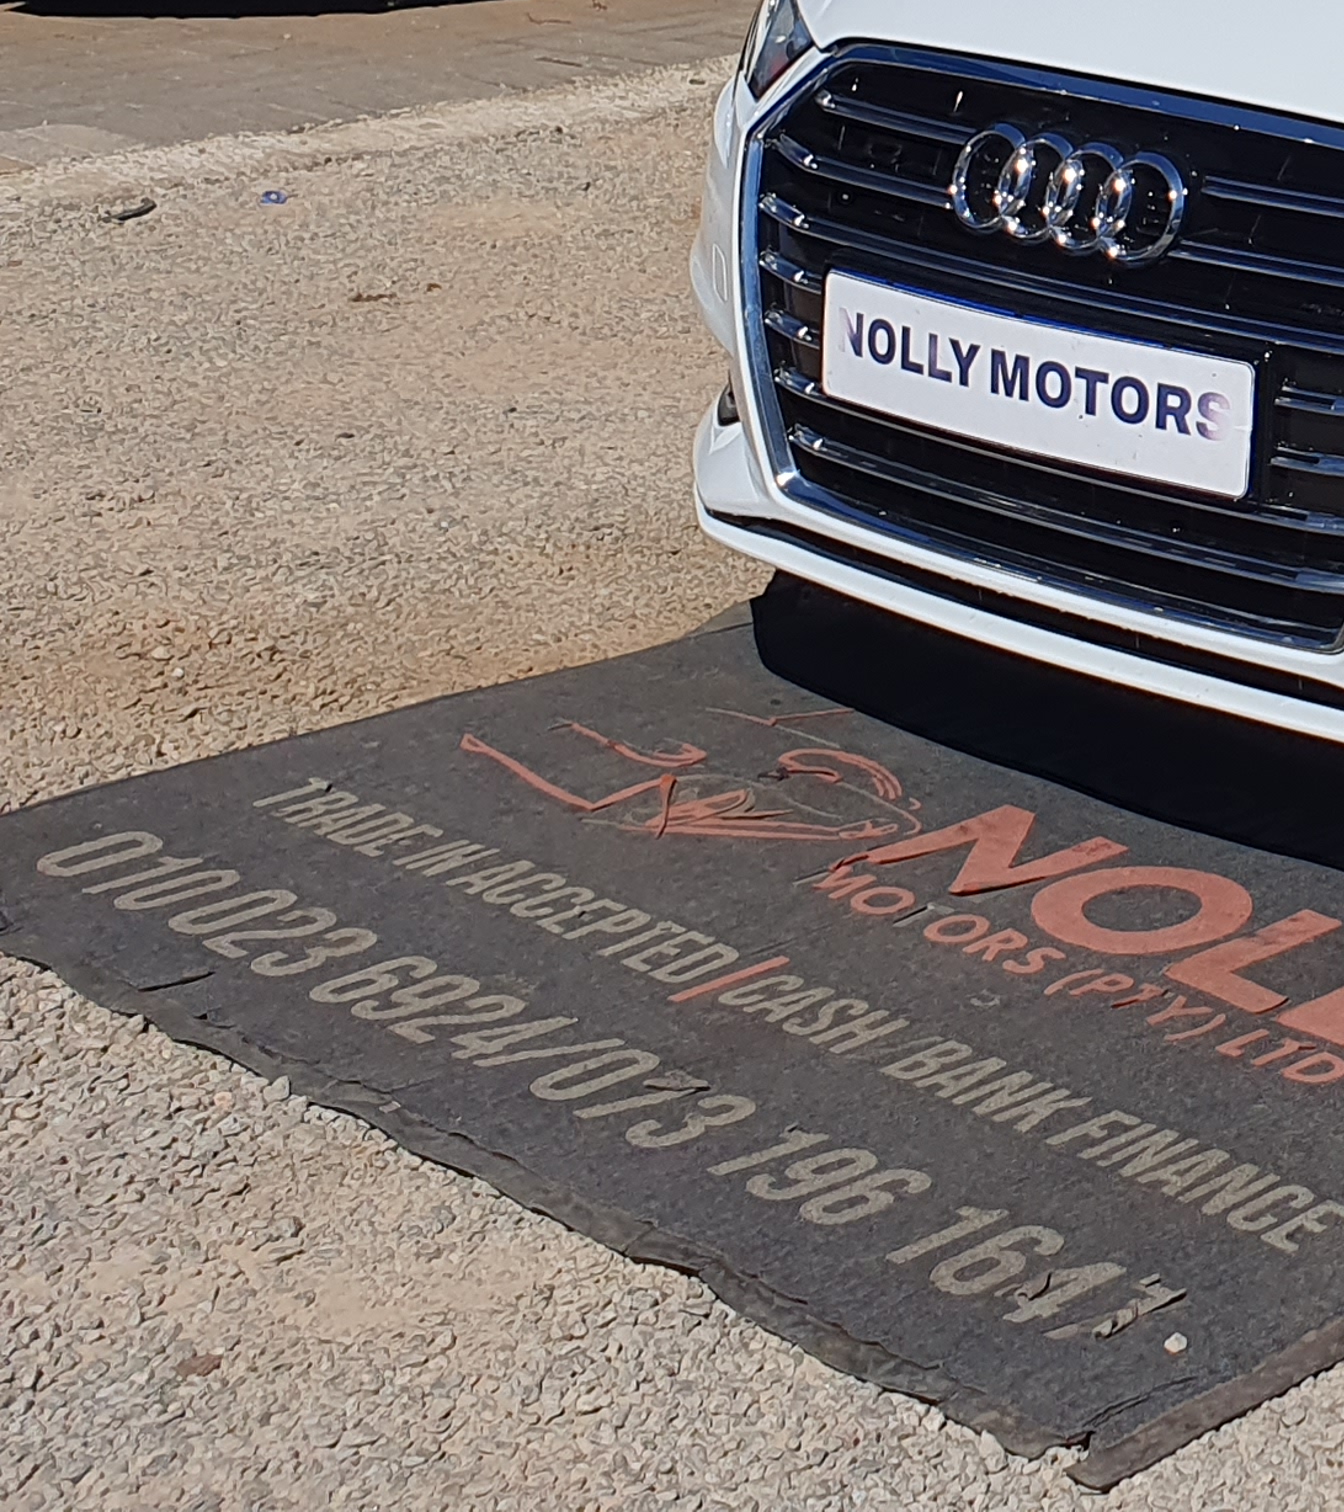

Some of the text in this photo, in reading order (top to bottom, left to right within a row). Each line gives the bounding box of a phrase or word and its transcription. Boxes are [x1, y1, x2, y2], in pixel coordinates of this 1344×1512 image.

[838, 307, 1232, 442] NOLLY MOTORS
[252, 777, 444, 858] TRADE
[391, 839, 501, 877] IN
[36, 830, 240, 911] 010
[167, 888, 378, 977] 023
[705, 1122, 933, 1225] 196
